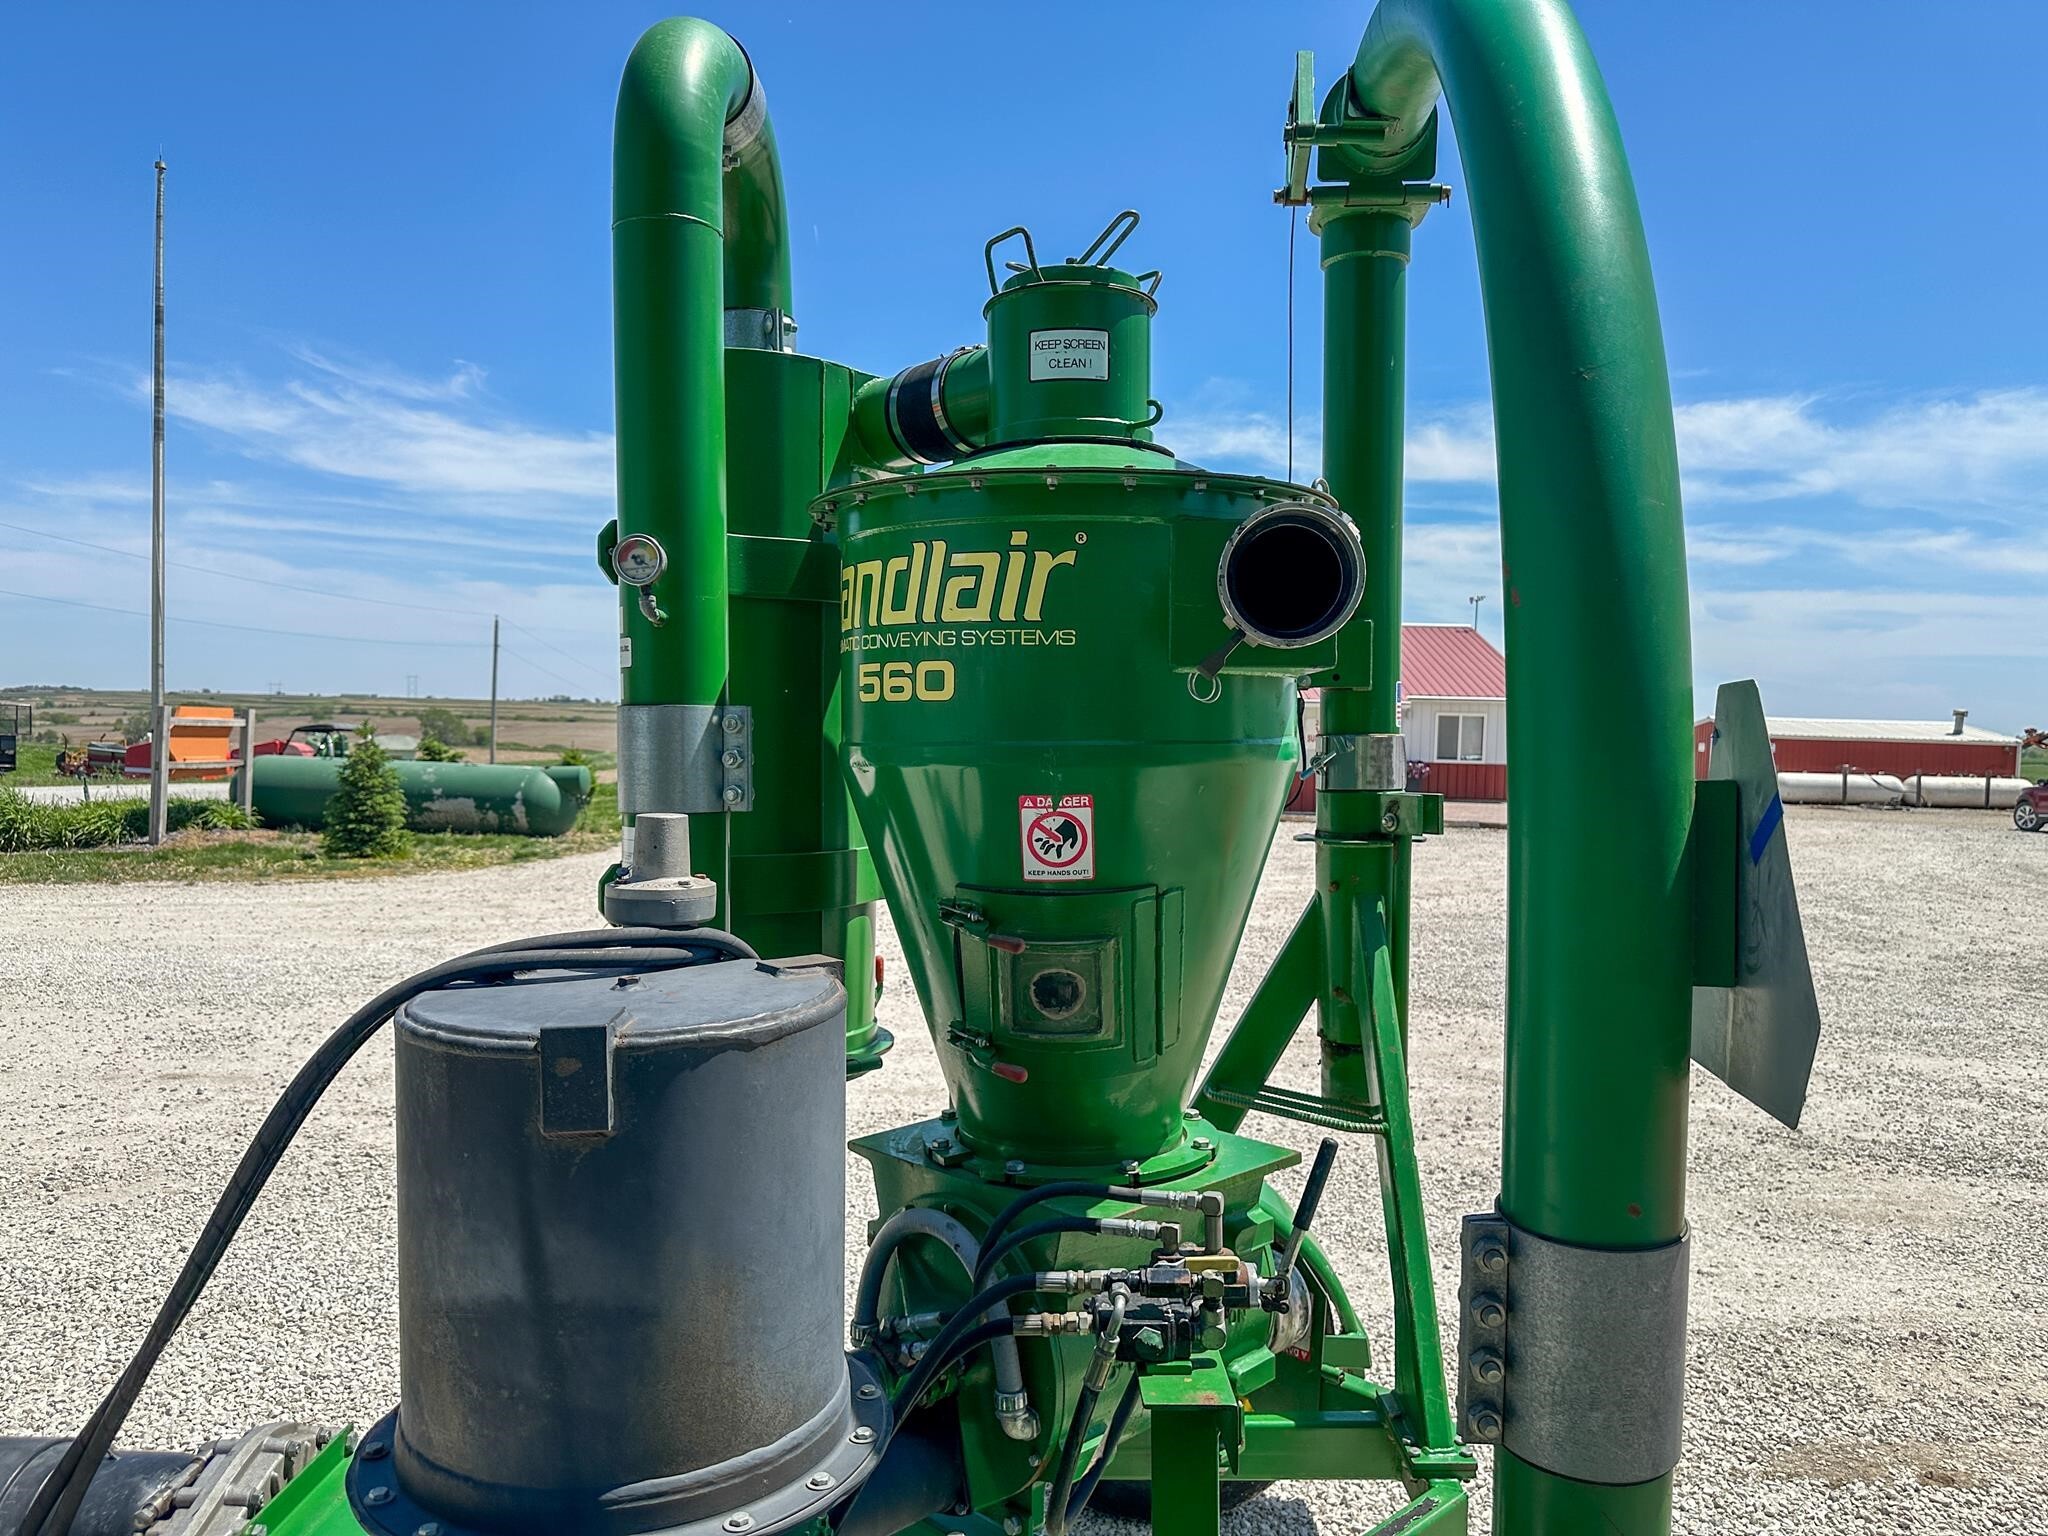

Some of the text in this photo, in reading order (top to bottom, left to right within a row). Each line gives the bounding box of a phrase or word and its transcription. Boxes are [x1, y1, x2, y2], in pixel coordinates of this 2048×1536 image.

[1034, 338, 1106, 351] KEEP SCREEN
[1048, 358, 1087, 369] CLEAN
[861, 630, 957, 650] CONVEYING
[960, 629, 1076, 647] SYSTEMS
[858, 660, 956, 702] 560
